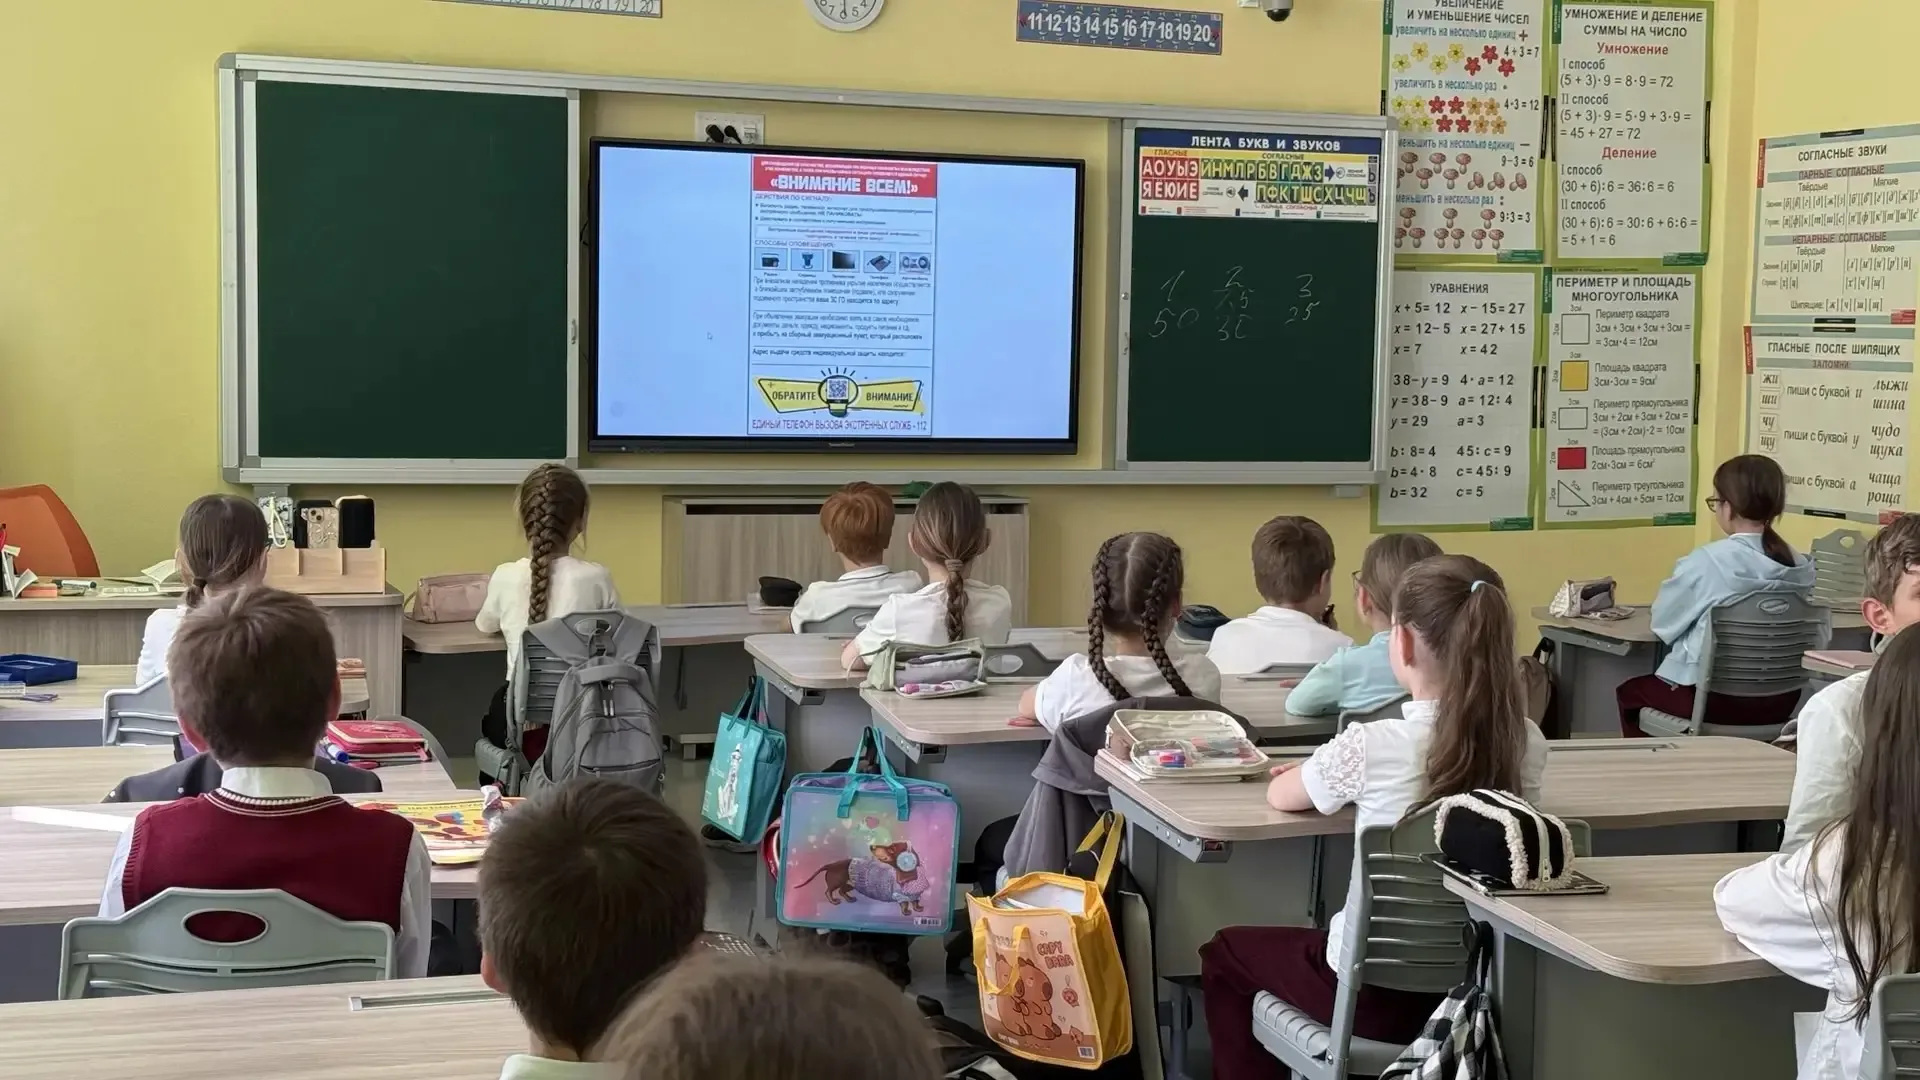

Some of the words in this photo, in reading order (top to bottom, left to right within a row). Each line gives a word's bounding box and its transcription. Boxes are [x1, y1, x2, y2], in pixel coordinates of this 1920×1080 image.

[828, 5, 835, 15] 7
[1435, 0, 1504, 10] УВЕЛИЧЕНИЕ
[852, 6, 858, 17] 5
[1407, 10, 1415, 20] И
[1417, 10, 1492, 23] УМЕНЬШЕНИЕ
[1495, 14, 1530, 24] ЧИСЕЛ
[1565, 8, 1637, 21] УМНОЖЕНИЕ
[1641, 10, 1648, 20] И
[1651, 11, 1703, 22] ДЕЛЕНИЕ
[1028, 12, 1043, 30] 11
[1046, 13, 1062, 32] 12
[1065, 15, 1080, 33] 13
[1084, 16, 1100, 34] 14
[1103, 18, 1119, 36] 15
[1122, 19, 1137, 37] 16
[1140, 20, 1156, 39] 17
[1158, 21, 1173, 40] 18
[1176, 23, 1191, 41] 19
[1193, 24, 1211, 42] 20
[1395, 26, 1436, 38] увеличить
[1439, 28, 1448, 36] на
[1449, 28, 1487, 38] несколько
[1489, 30, 1516, 40] единиц
[1584, 25, 1627, 36] СУММЫ
[1631, 25, 1646, 36] НА
[1650, 26, 1687, 37] ЧИСЛО
[1597, 42, 1668, 55] Умножение
[1569, 59, 1606, 70] способ
[1394, 79, 1436, 91] увеличить
[1438, 80, 1443, 89] в
[1445, 80, 1482, 90] несколько
[1484, 82, 1497, 93] раз
[1572, 94, 1608, 105] способ
[1191, 136, 1231, 147] ЛЕНТА
[1239, 138, 1269, 149] БУКВ
[1277, 140, 1286, 149] И
[1293, 140, 1340, 151] ЗВУКОВ
[1439, 140, 1447, 148] на
[1449, 140, 1486, 149] несколько
[1487, 141, 1514, 151] единиц
[1602, 147, 1656, 160] Деление
[1798, 148, 1854, 162] СОГЛАСНЫЕ
[1858, 145, 1887, 157] ЗВУКИ
[1567, 165, 1603, 176] способ
[1799, 169, 1832, 180] ПАРНЫЕ
[1836, 165, 1885, 178] СОГЛАСНЫЕ
[771, 175, 861, 192] «ВНИМАНИЕ
[866, 179, 918, 194] ВСЕМ!»
[1873, 177, 1899, 187] Мягкие
[1444, 196, 1480, 204] несколько
[1481, 196, 1493, 207] раз
[1571, 199, 1606, 210] способ
[1792, 233, 1834, 243] НЕПАРНЫЕ
[1838, 232, 1887, 242] СОГЛАСНЫЕ
[1870, 244, 1895, 254] Мягкие
[1226, 266, 1244, 288] 2
[1556, 277, 1618, 287] ПЕРИМЕТР
[1622, 277, 1629, 287] И
[1633, 277, 1692, 288] ПЛОЩАДЬ
[1160, 270, 1185, 301] 1
[1296, 274, 1313, 298] 3
[1430, 284, 1488, 293] УРАВНЕНИЯ
[1572, 292, 1679, 302] МНОГОУГОЛЬНИКА
[1596, 309, 1634, 320] Периметр
[1636, 310, 1670, 320] квадрата
[1148, 308, 1200, 338] 50
[1480, 344, 1498, 355] 42
[1768, 342, 1810, 353] ГЛАСНЫЕ
[1815, 343, 1847, 354] ПОСЛЕ
[1852, 344, 1900, 357] ШИПЯЩИХ
[1595, 363, 1630, 373] Площадь
[1633, 363, 1667, 374] квадрата
[1762, 374, 1778, 384] жи
[1873, 379, 1908, 391] лыжи
[772, 391, 816, 400] ОБРАТИТЕ
[867, 392, 913, 401] ВНИМАНИЕ
[1787, 386, 1810, 396] пиши
[1819, 385, 1850, 399] буквой
[1856, 389, 1862, 398] и
[1593, 399, 1629, 409] Периметр
[1631, 399, 1688, 410] прямоугольника
[1762, 394, 1777, 404] ши
[1872, 398, 1905, 410] шина
[752, 419, 781, 429] ЕДИНЫЙ
[783, 420, 814, 429] ТЕЛЕФОН
[815, 420, 842, 429] ВЫЗОВА
[844, 420, 888, 430] ЭКСТРЕННЫХ
[889, 421, 912, 430] СЛУЖБ
[916, 421, 927, 430] 112
[1762, 416, 1774, 428] чу
[1871, 422, 1900, 440] чудо
[1784, 430, 1808, 440] пиши
[1817, 431, 1848, 444] буквой
[1853, 434, 1859, 448] у
[1592, 447, 1626, 457] Площадь
[1627, 446, 1685, 457] прямоугольника
[1870, 443, 1903, 460] щука
[1807, 477, 1812, 486] с
[1815, 475, 1845, 490] буквой
[1850, 481, 1856, 490] а
[1869, 471, 1901, 488] чаща
[1592, 482, 1631, 492] Периметр
[1633, 480, 1684, 492] треугольника
[1867, 490, 1901, 507] роща
